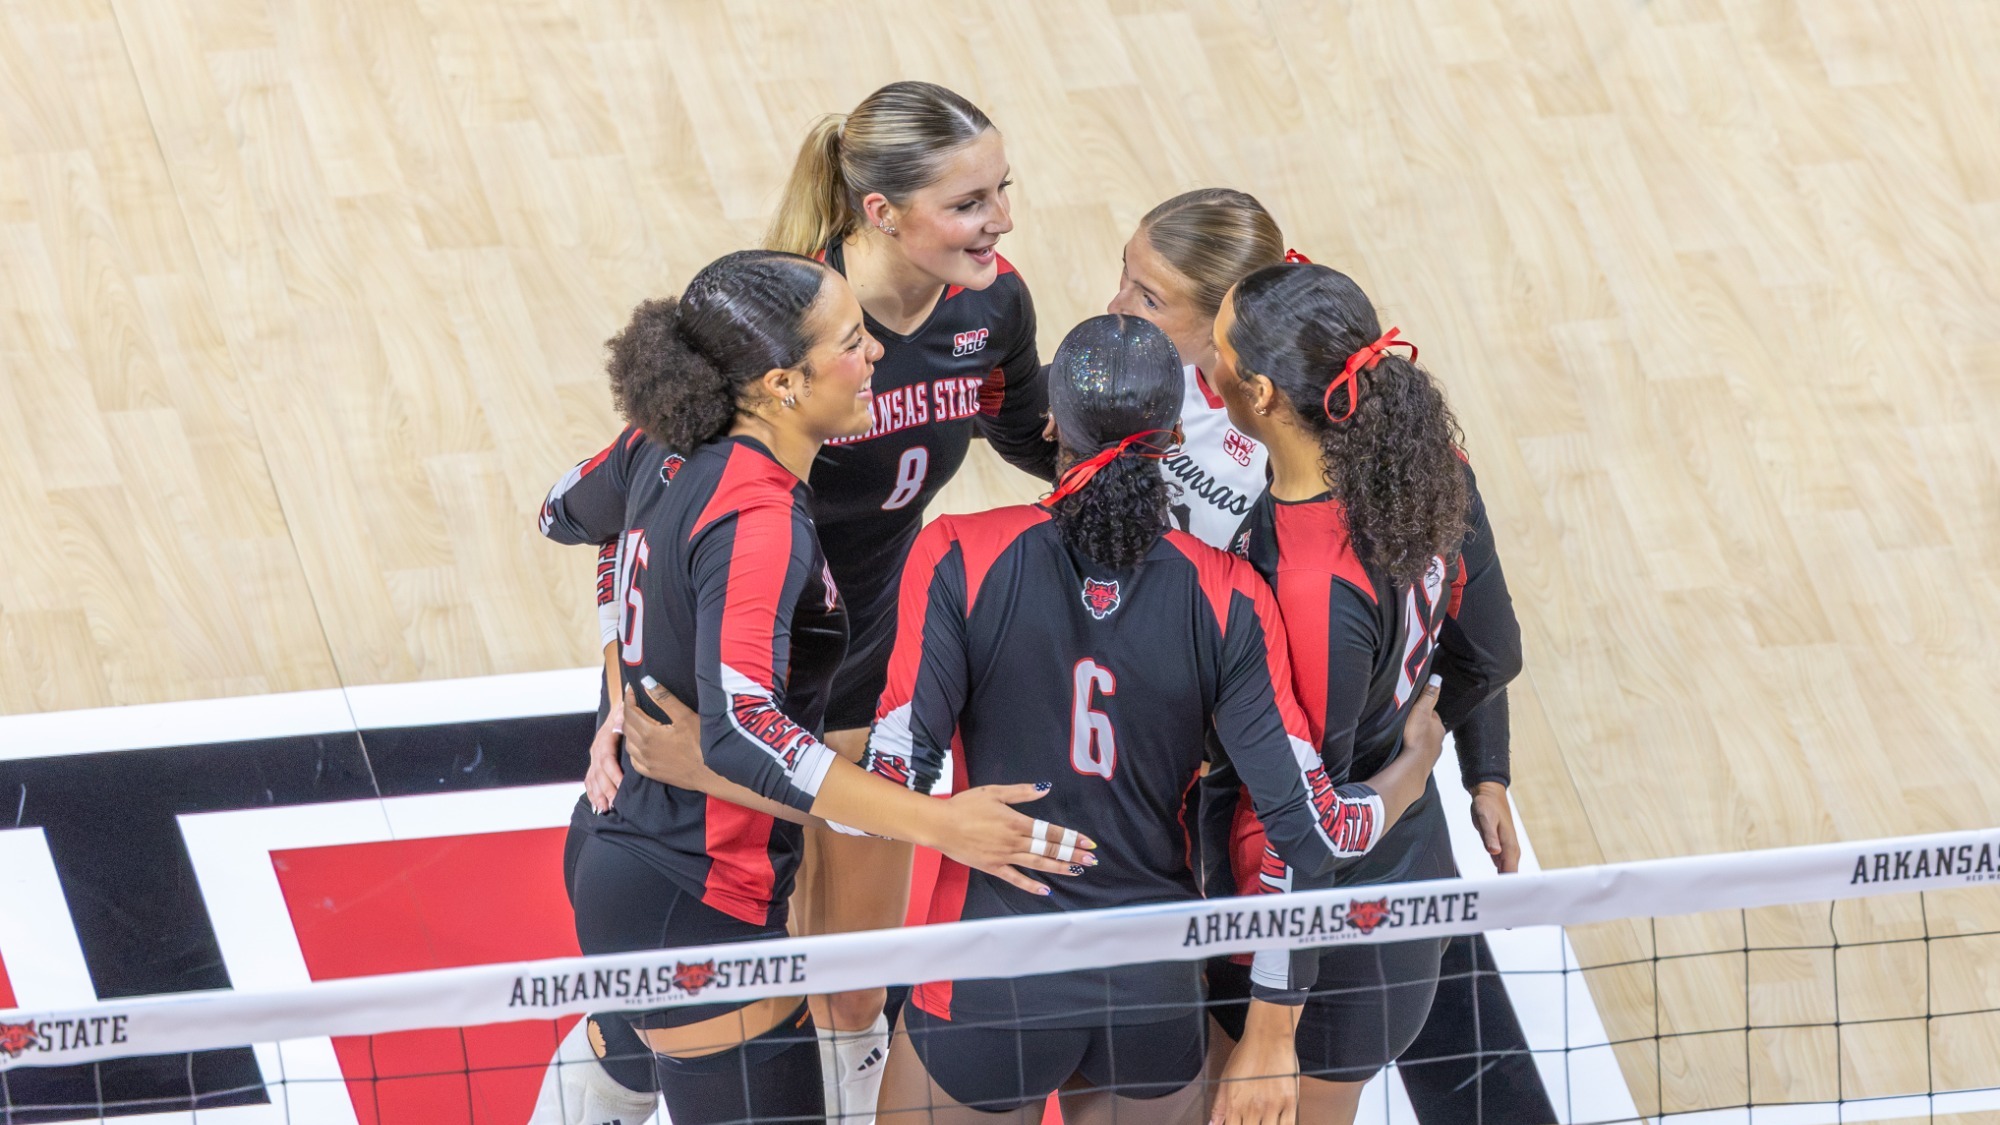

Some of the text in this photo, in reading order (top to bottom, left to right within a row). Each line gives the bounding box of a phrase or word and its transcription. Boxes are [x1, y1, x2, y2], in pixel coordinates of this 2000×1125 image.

[881, 445, 929, 511] 8
[1070, 656, 1117, 781] 6
[1850, 842, 2000, 885] ARKANSA
[1183, 891, 1479, 947] ARKANSAS STATE
[509, 954, 807, 1007] ARKANSAS STATE
[38, 1014, 129, 1052] STATE
